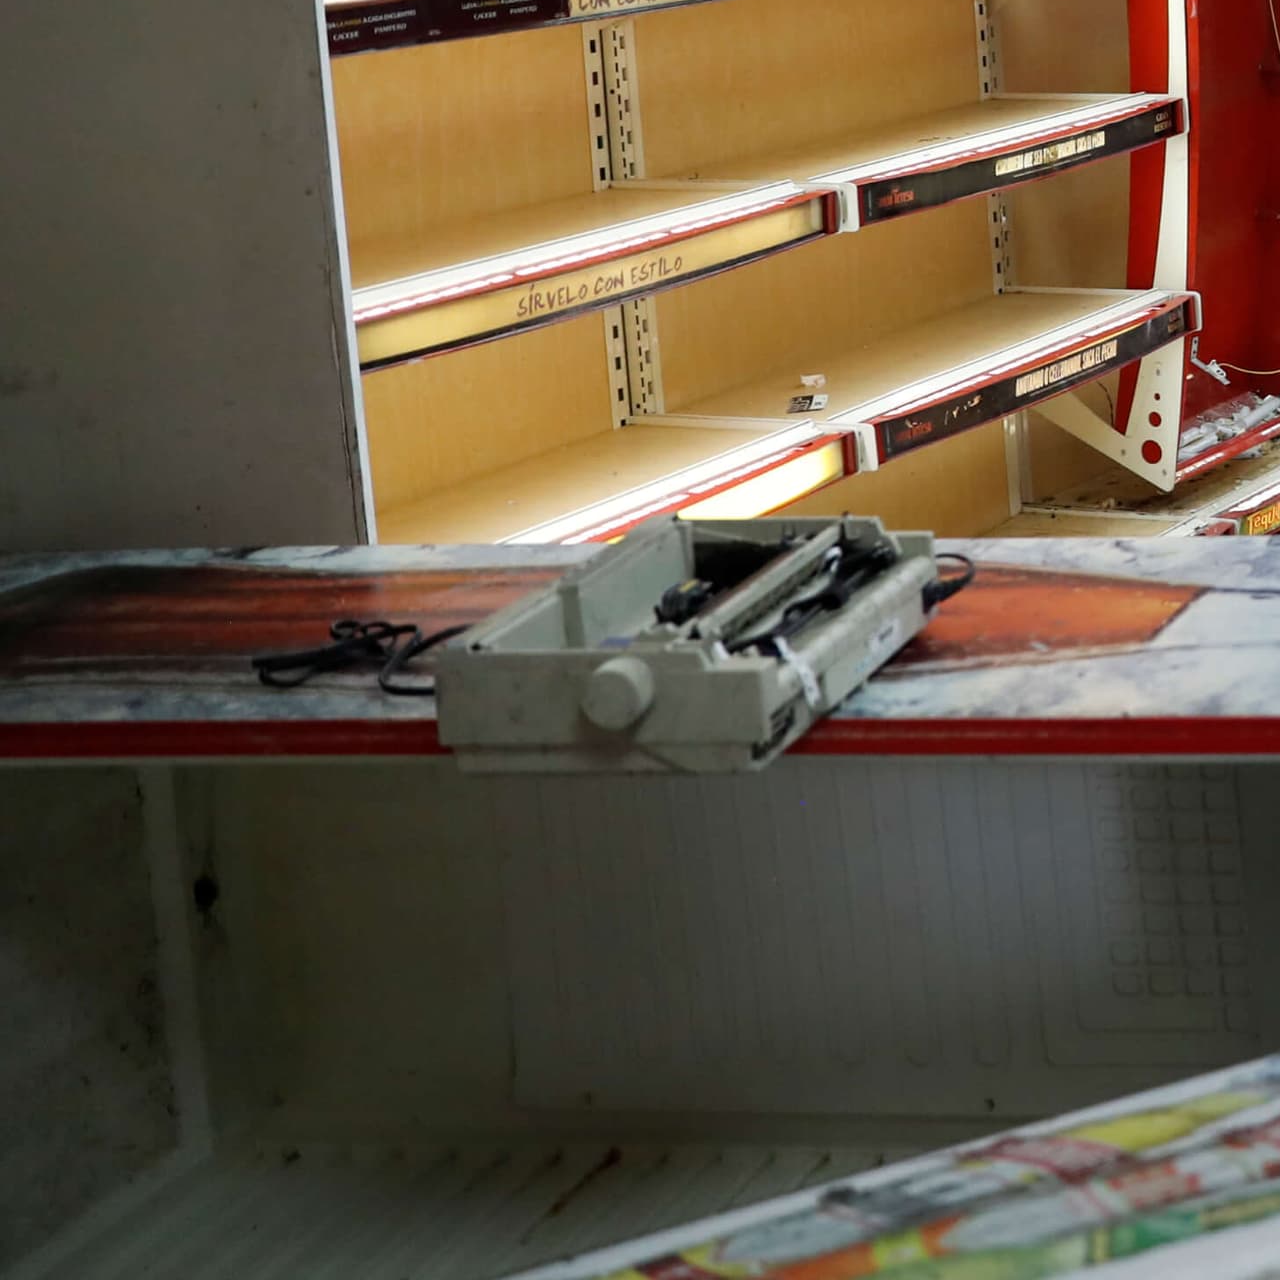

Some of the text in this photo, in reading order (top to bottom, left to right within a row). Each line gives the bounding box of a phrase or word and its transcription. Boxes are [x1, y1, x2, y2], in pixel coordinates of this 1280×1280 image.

[516, 255, 684, 318] SÍRVELO CON ESTILO
